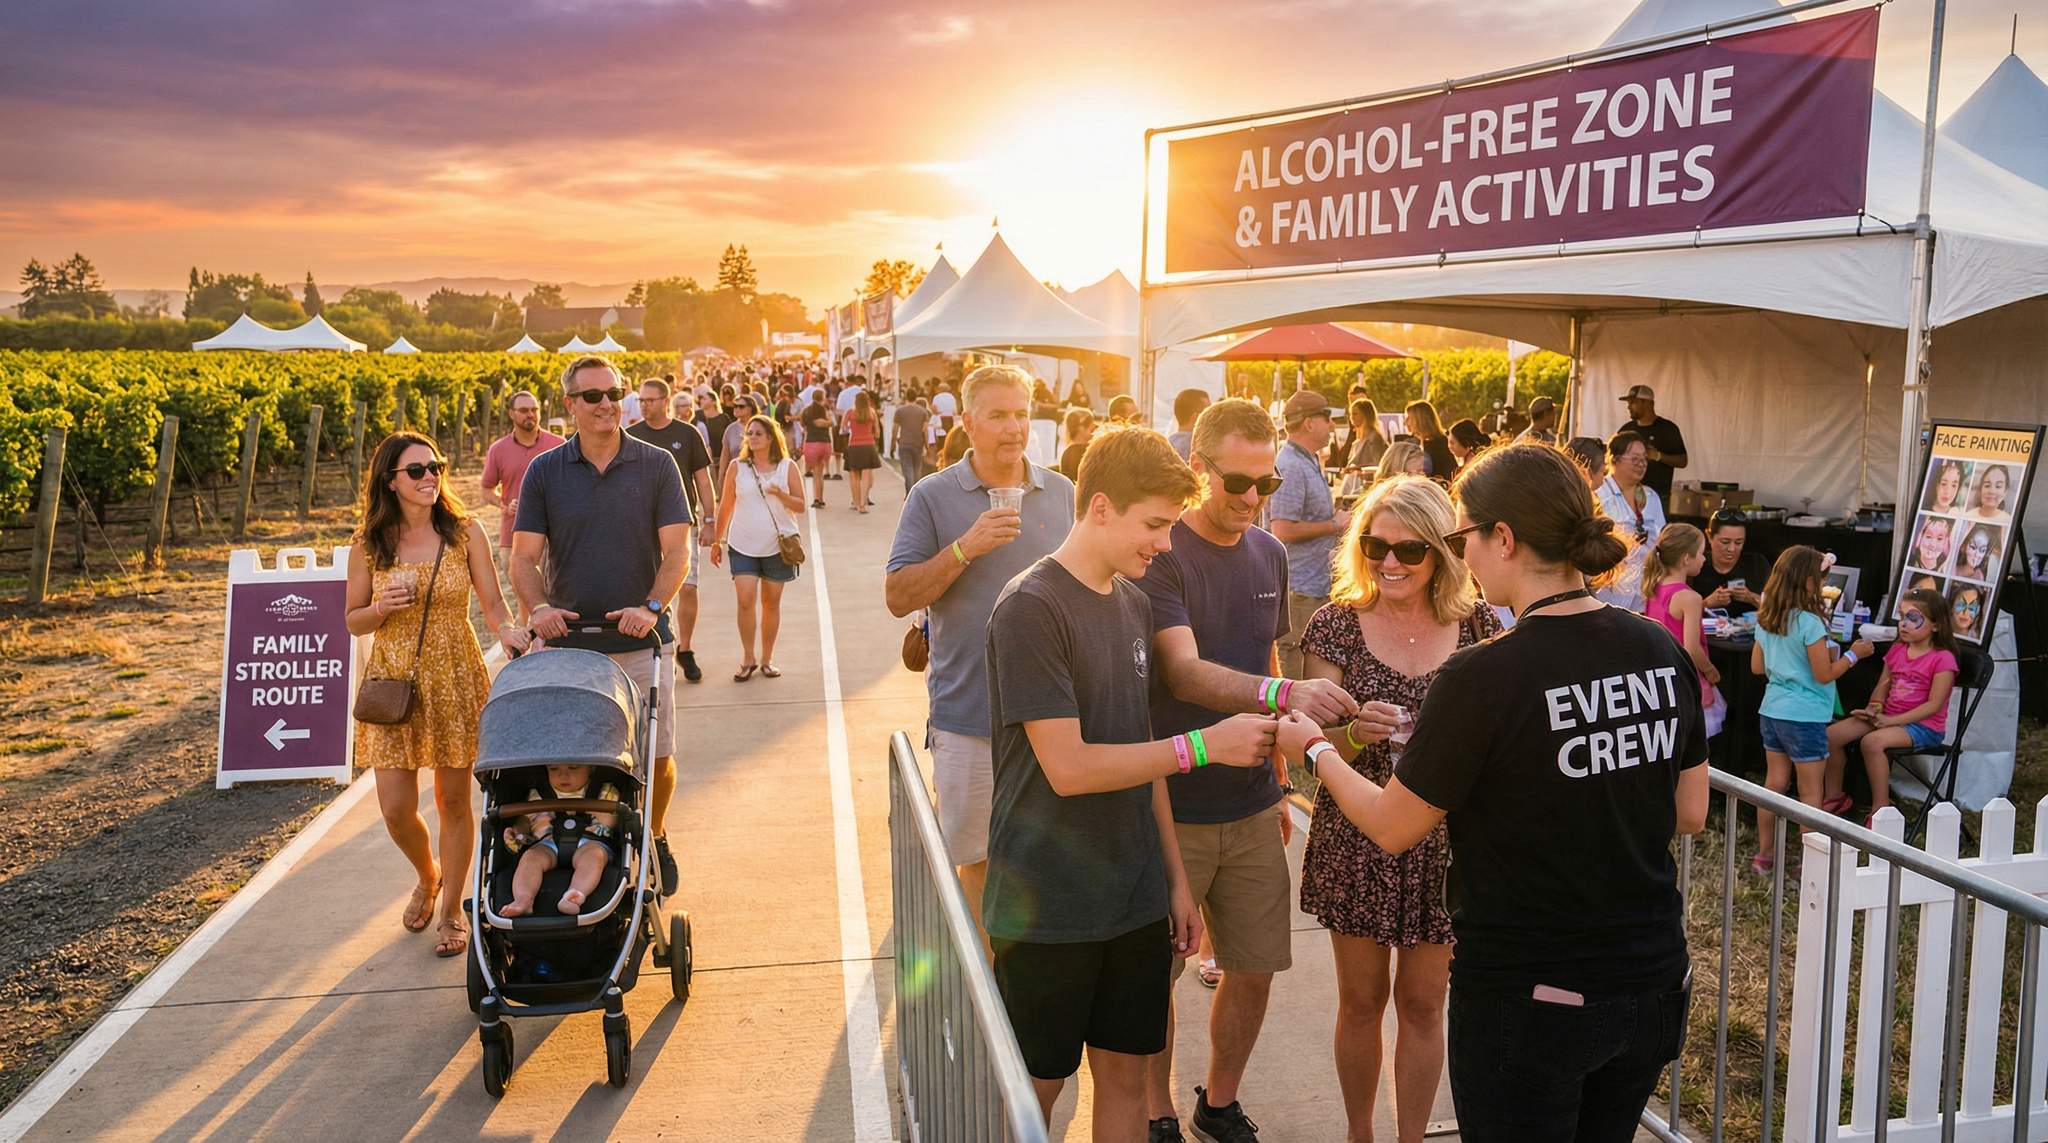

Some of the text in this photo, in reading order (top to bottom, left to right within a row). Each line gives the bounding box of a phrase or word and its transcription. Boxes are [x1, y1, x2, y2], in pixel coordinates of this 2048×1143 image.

[1234, 65, 1735, 192] ALCOHOL-FREE ZONE
[1235, 145, 1716, 247] & FAMILY ACTIVITIES
[1935, 433, 2032, 454] FACE PAINTING
[252, 634, 329, 655] FAMILY
[235, 659, 343, 681] STROLLER
[251, 686, 324, 706] ROUTE
[1544, 667, 1677, 731] EVENT
[1557, 718, 1679, 779] CREW
